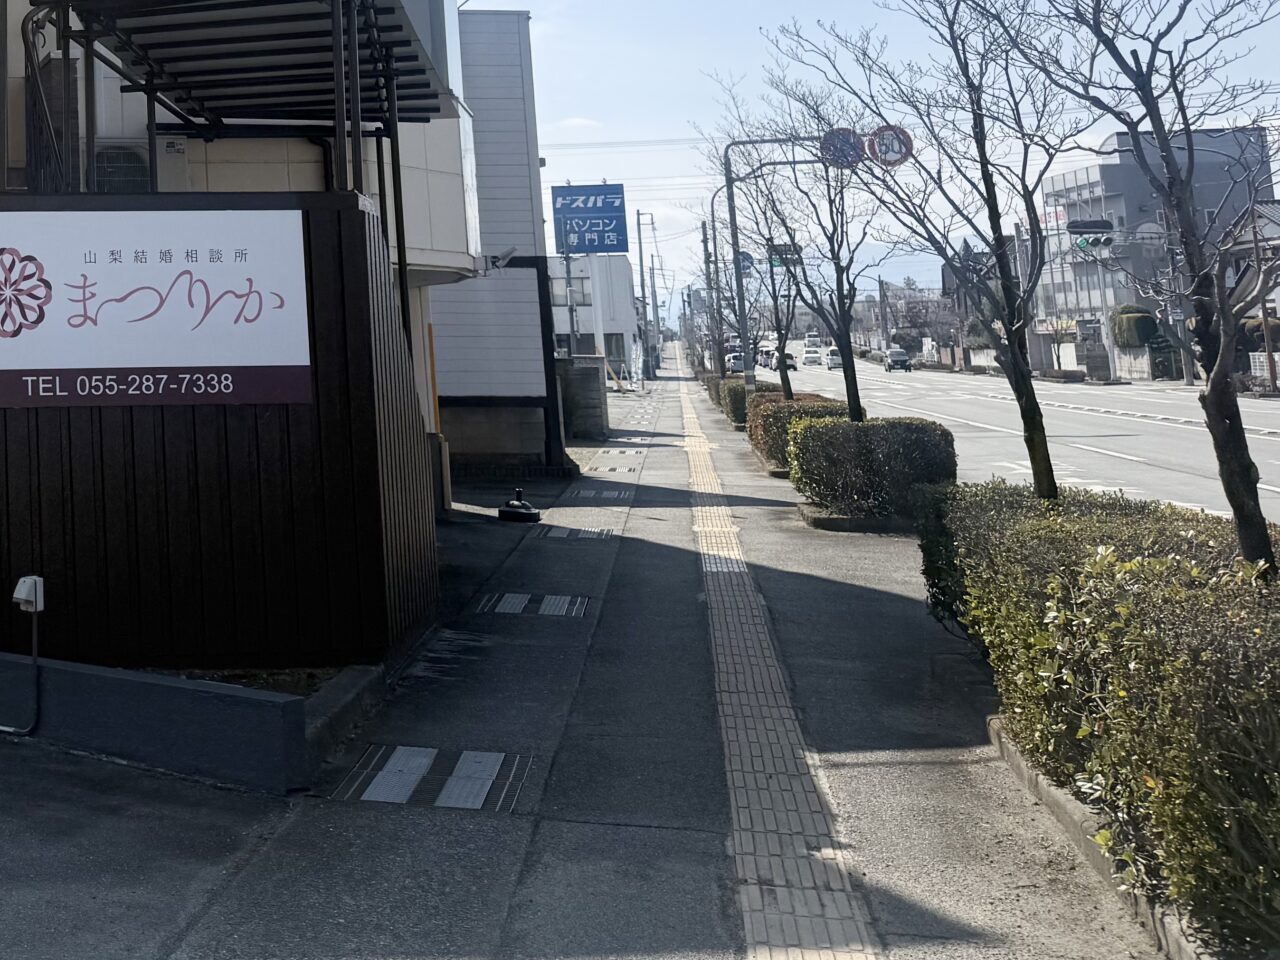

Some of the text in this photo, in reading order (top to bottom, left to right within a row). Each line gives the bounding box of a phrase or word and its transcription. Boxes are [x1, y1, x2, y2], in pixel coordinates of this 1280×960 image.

[567, 219, 616, 232] パソコン
[84, 248, 249, 264] 山梨結婚相談所
[64, 269, 285, 331] まつりか
[22, 374, 234, 396] TEL 055-287-7338
